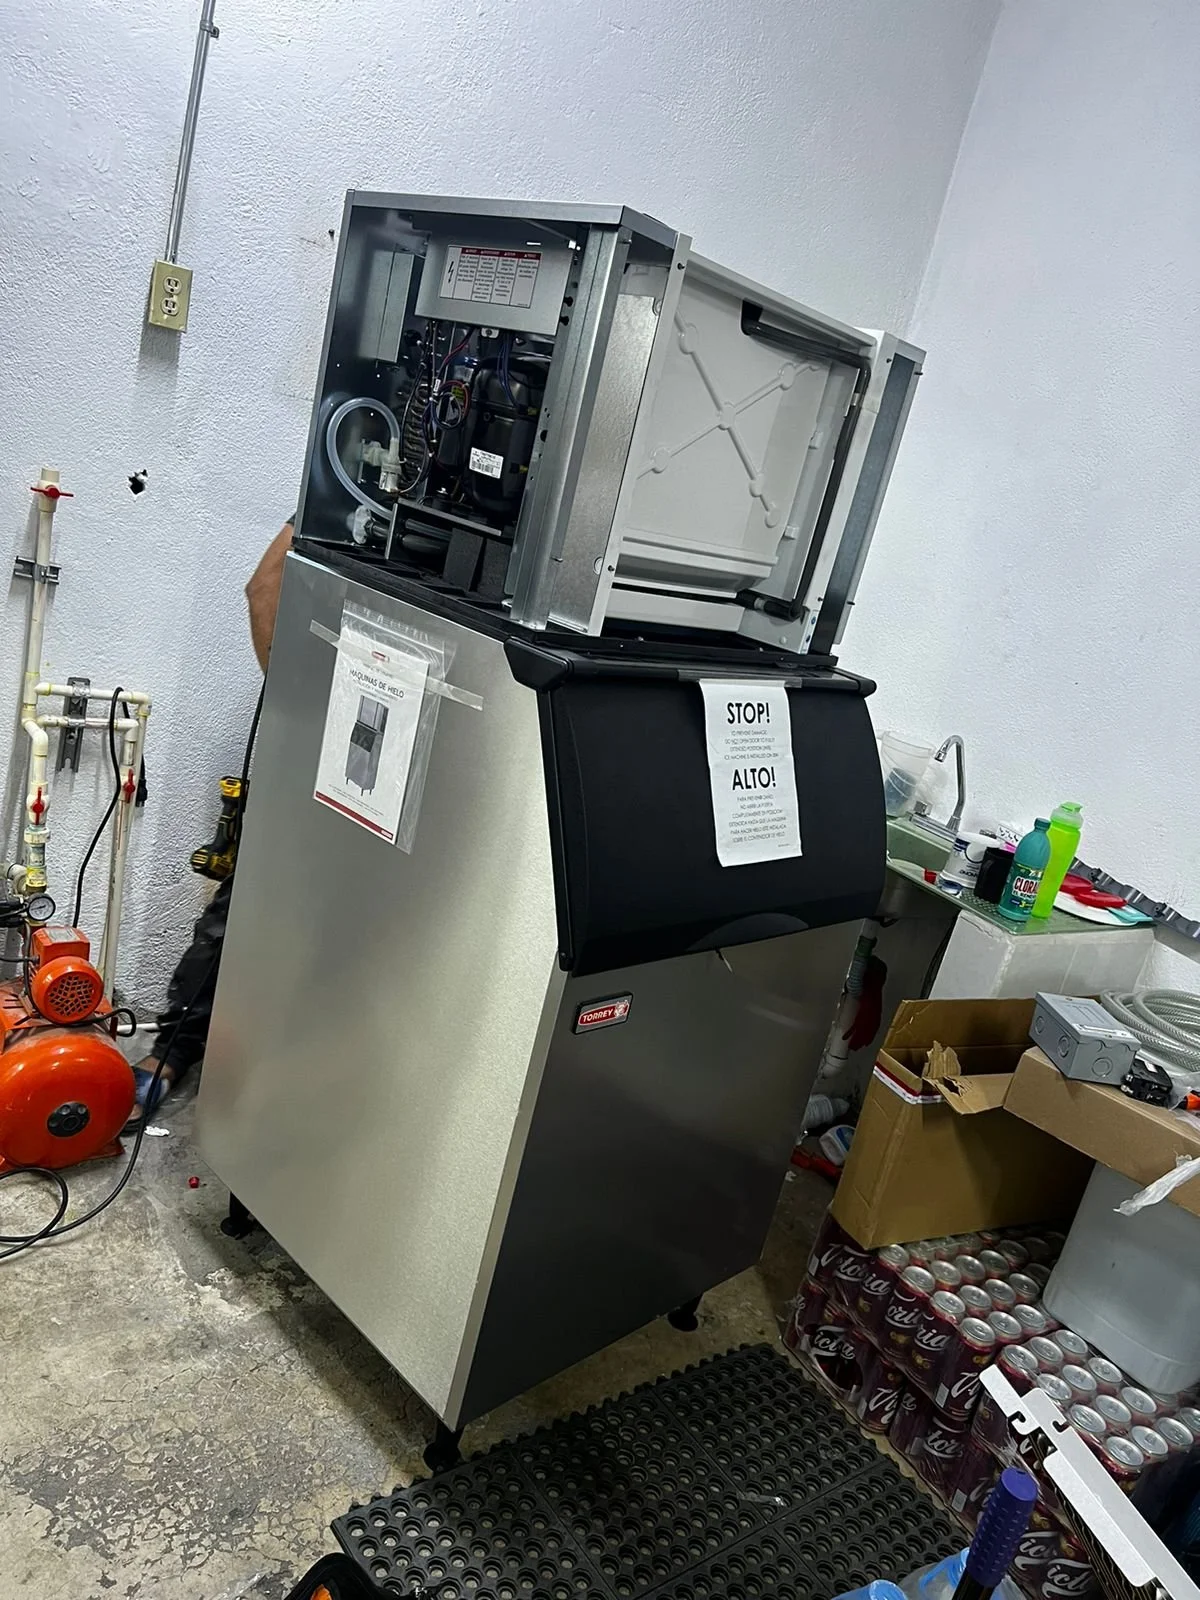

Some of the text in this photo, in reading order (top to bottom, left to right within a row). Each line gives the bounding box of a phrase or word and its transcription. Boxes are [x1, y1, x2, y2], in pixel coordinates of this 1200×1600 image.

[379, 681, 387, 690] DE
[388, 686, 405, 698] HIELO
[727, 702, 770, 724] STOP!
[732, 766, 776, 790] ALTO!
[1014, 877, 1040, 894] CLORA
[582, 1008, 613, 1022] TORREY
